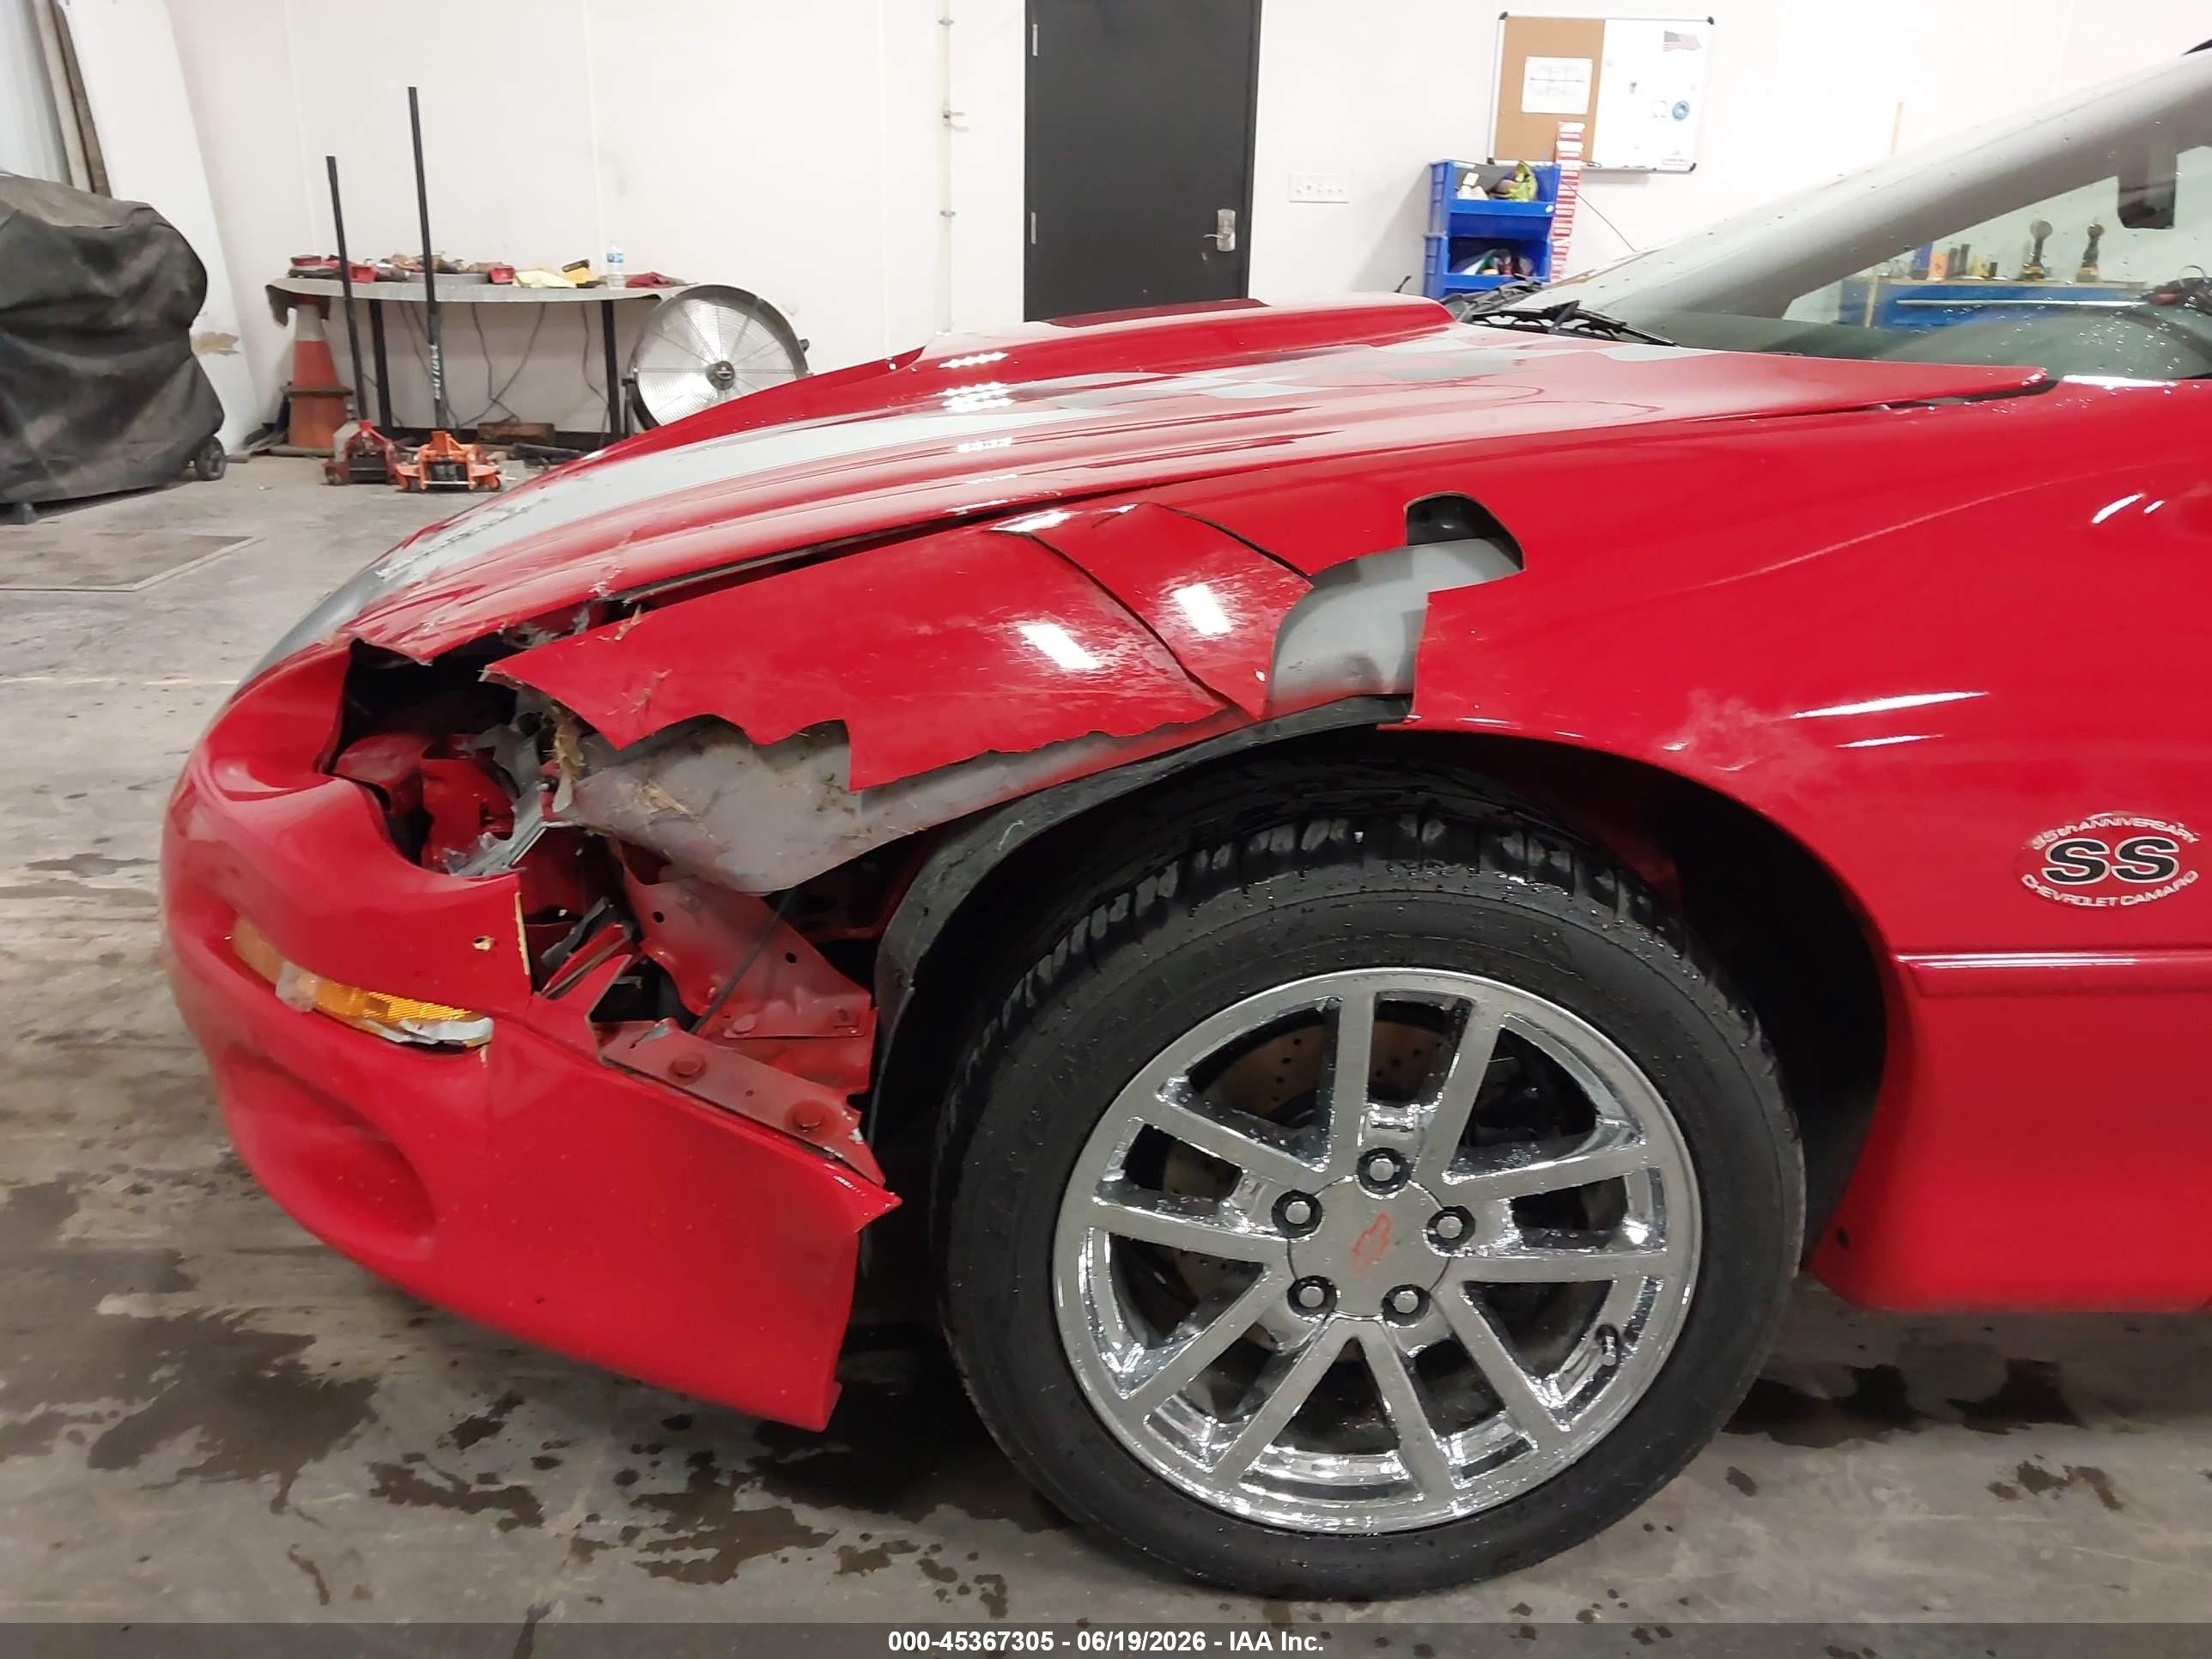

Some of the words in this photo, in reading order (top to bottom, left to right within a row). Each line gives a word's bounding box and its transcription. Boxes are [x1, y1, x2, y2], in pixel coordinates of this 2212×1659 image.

[2078, 817, 2201, 844] ANNIVERSARY
[2041, 836, 2180, 885] SS
[2021, 873, 2119, 907] CHEVROLET
[2120, 870, 2199, 906] CAMARO
